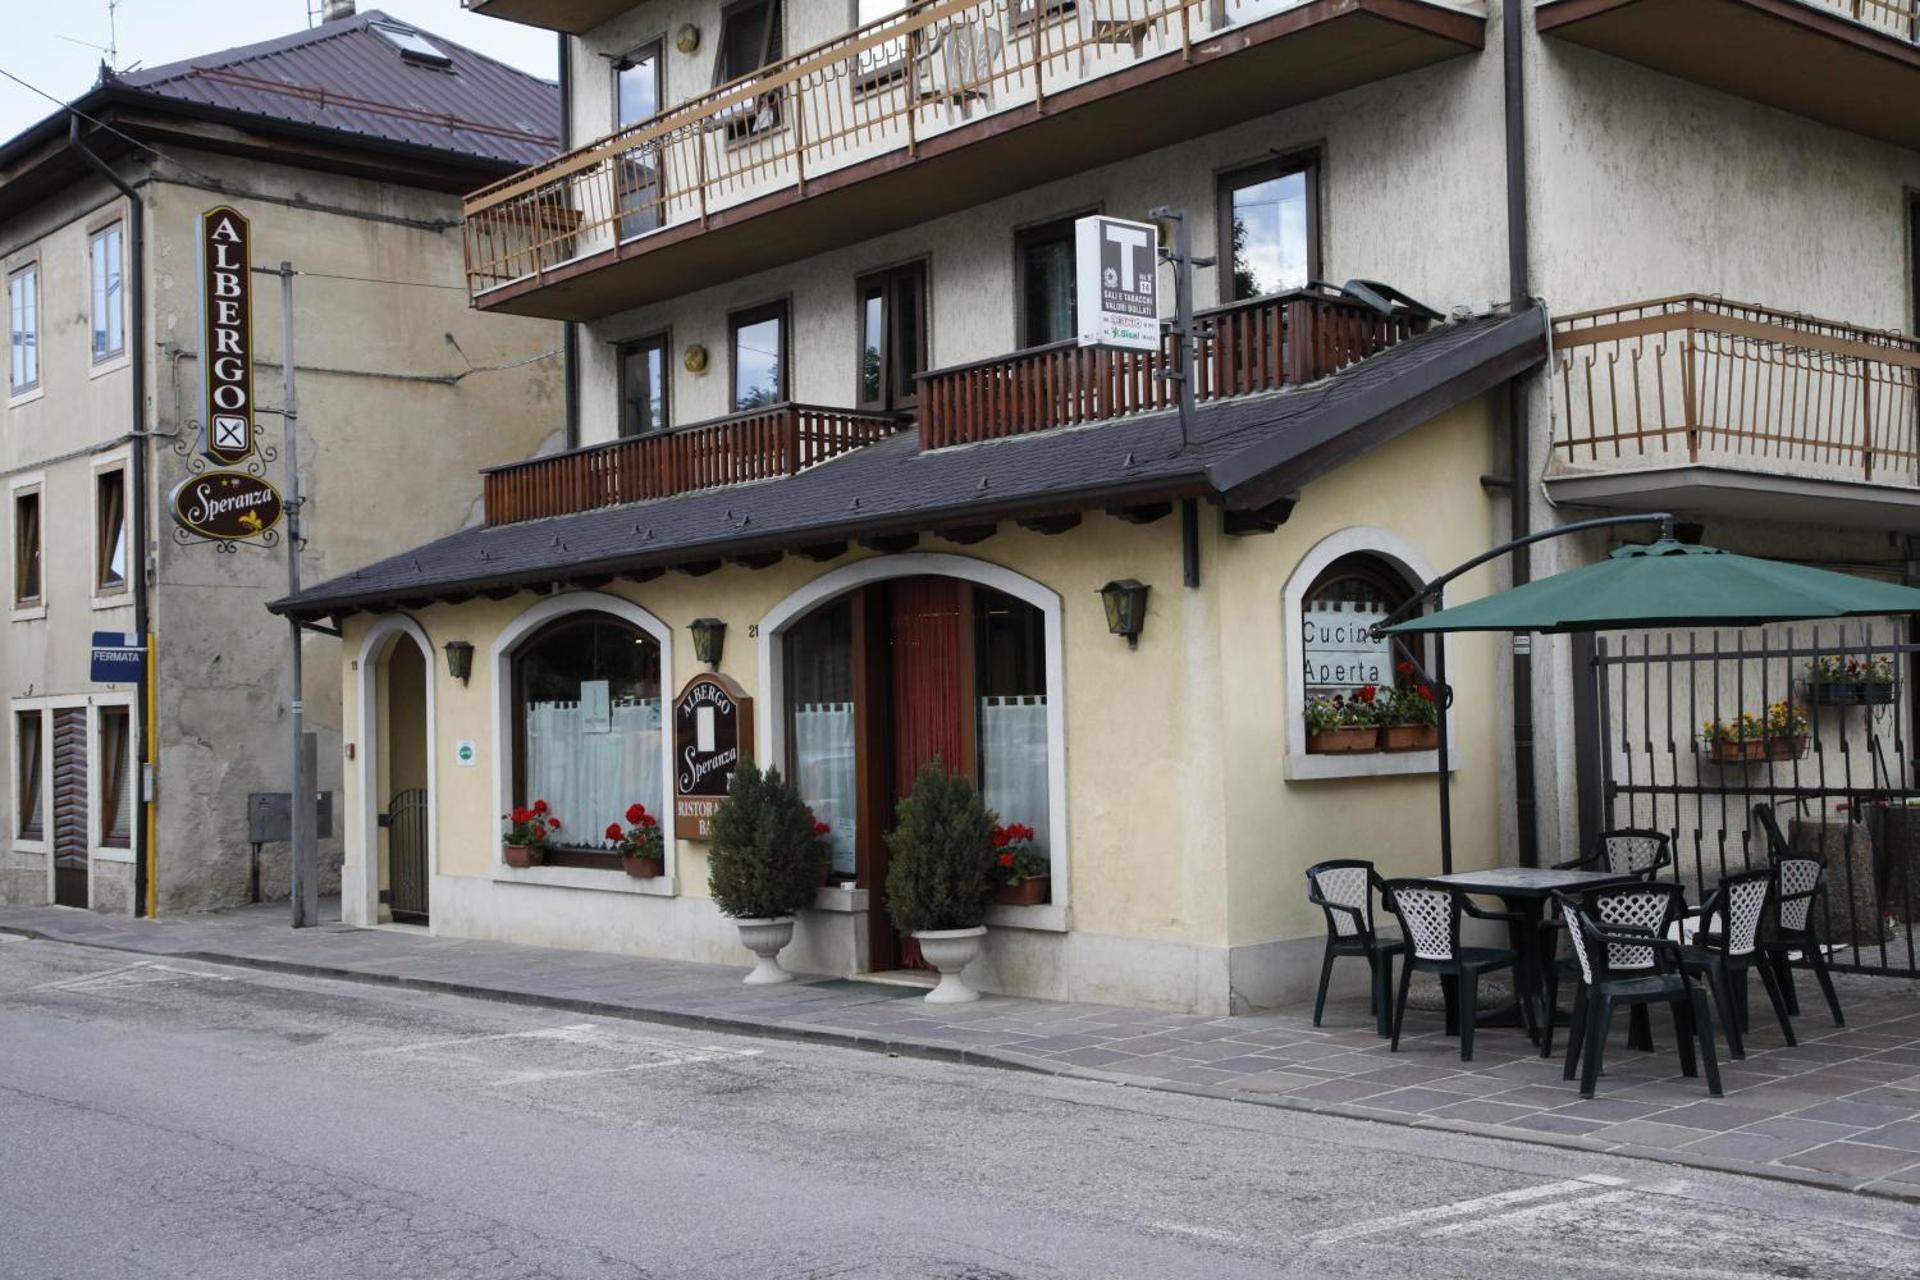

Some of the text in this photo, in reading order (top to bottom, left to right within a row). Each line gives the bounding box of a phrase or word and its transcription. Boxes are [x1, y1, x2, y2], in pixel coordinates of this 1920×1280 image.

[1106, 225, 1147, 292] T
[1104, 290, 1117, 300] SALI
[1124, 294, 1153, 306] TABACCHI
[1105, 301, 1152, 316] VALORI BOLLATI
[211, 217, 246, 410] ALBERGO
[188, 482, 273, 525] Speranza
[748, 624, 759, 638] 21
[94, 651, 140, 662] FERMATA
[1304, 658, 1379, 683] Aperta
[682, 682, 731, 718] ALBERGO
[679, 745, 737, 794] Speranza
[699, 820, 713, 836] BA
